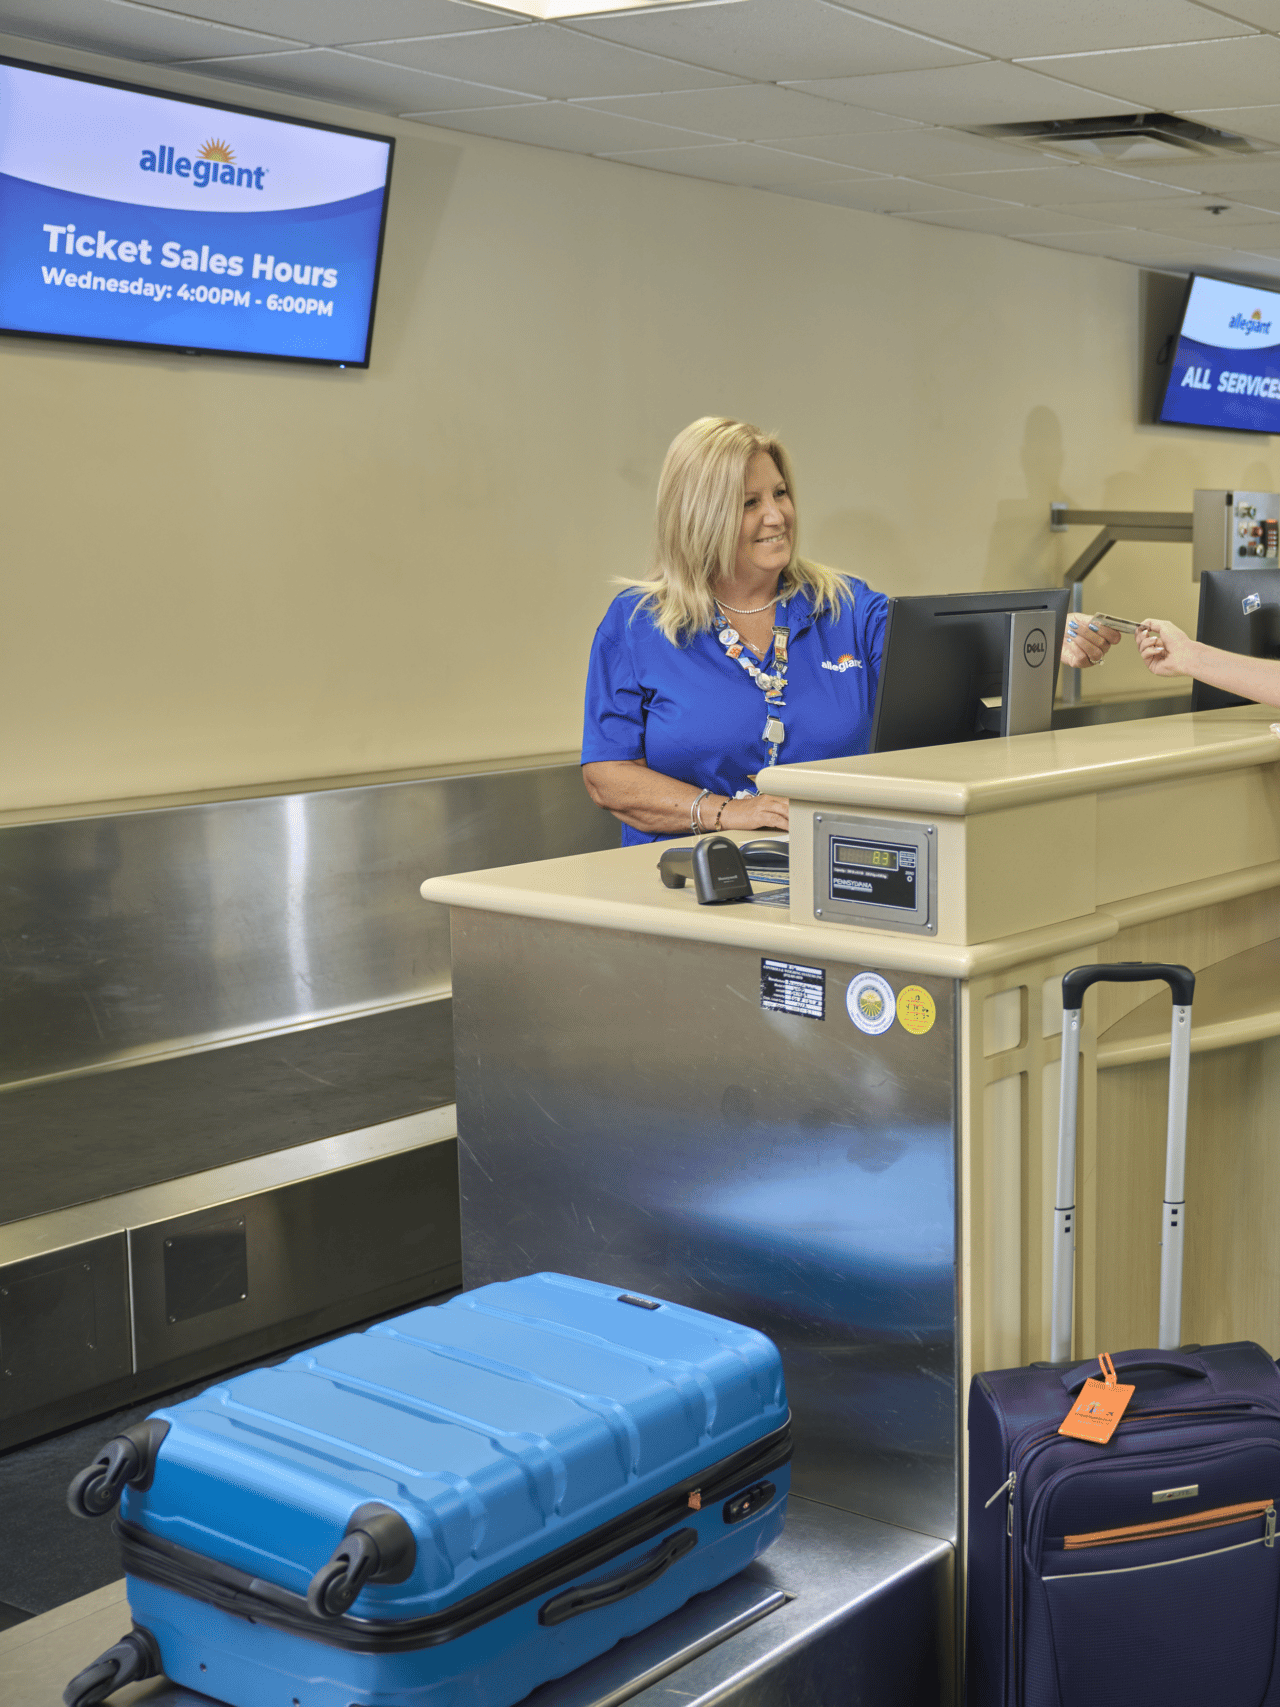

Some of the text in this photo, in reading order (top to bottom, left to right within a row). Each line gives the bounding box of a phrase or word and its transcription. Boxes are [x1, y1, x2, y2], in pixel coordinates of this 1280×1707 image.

[139, 145, 265, 190] allegiant
[42, 223, 338, 288] Ticket Sales Hours
[41, 265, 172, 302] Wednesday:
[176, 283, 251, 308] 4:00PM
[266, 293, 334, 317] 6:00PM
[1228, 312, 1272, 336] allegiant
[1180, 366, 1212, 390] ALL
[1027, 643, 1044, 653] DELL
[821, 660, 863, 673] allegiant
